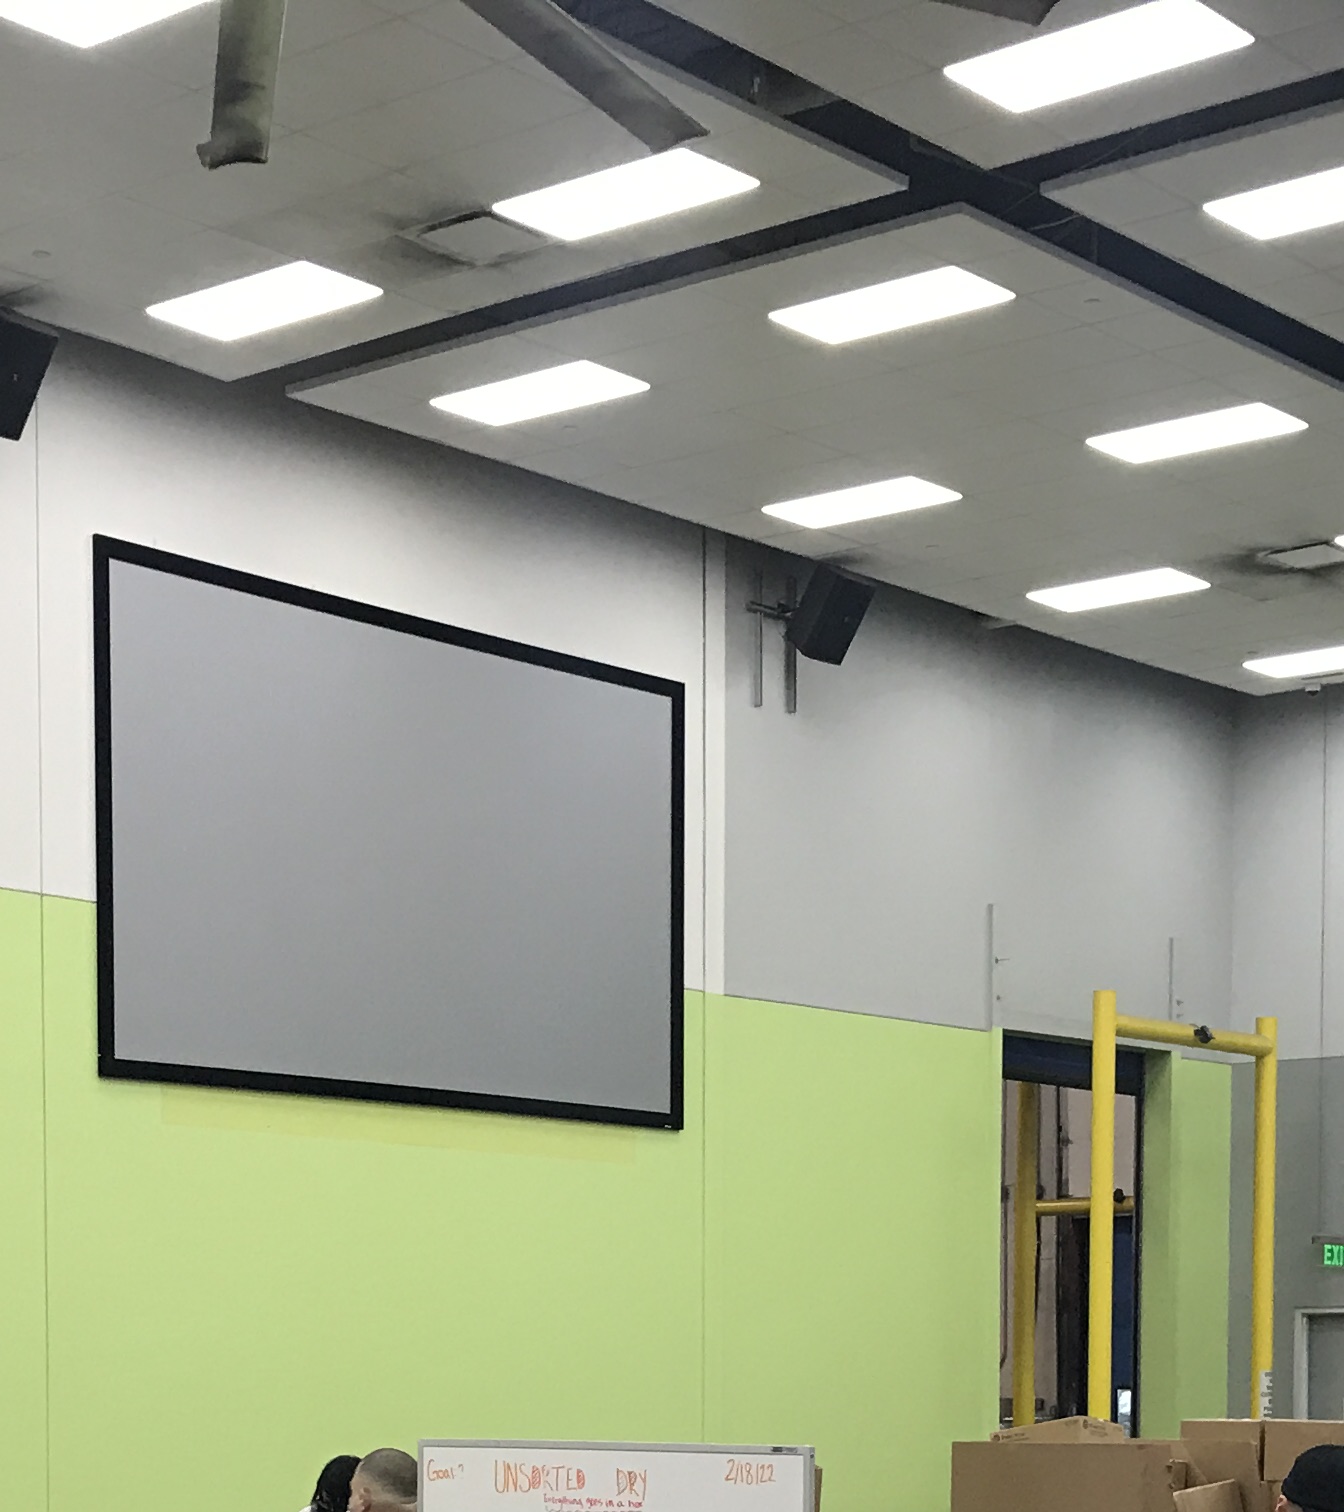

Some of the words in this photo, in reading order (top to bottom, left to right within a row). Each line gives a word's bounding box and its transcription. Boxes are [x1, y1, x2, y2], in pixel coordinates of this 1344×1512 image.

[494, 1459, 586, 1494] UNSORTED
[616, 1467, 648, 1501] DRY
[725, 1458, 777, 1485] 2/18/22
